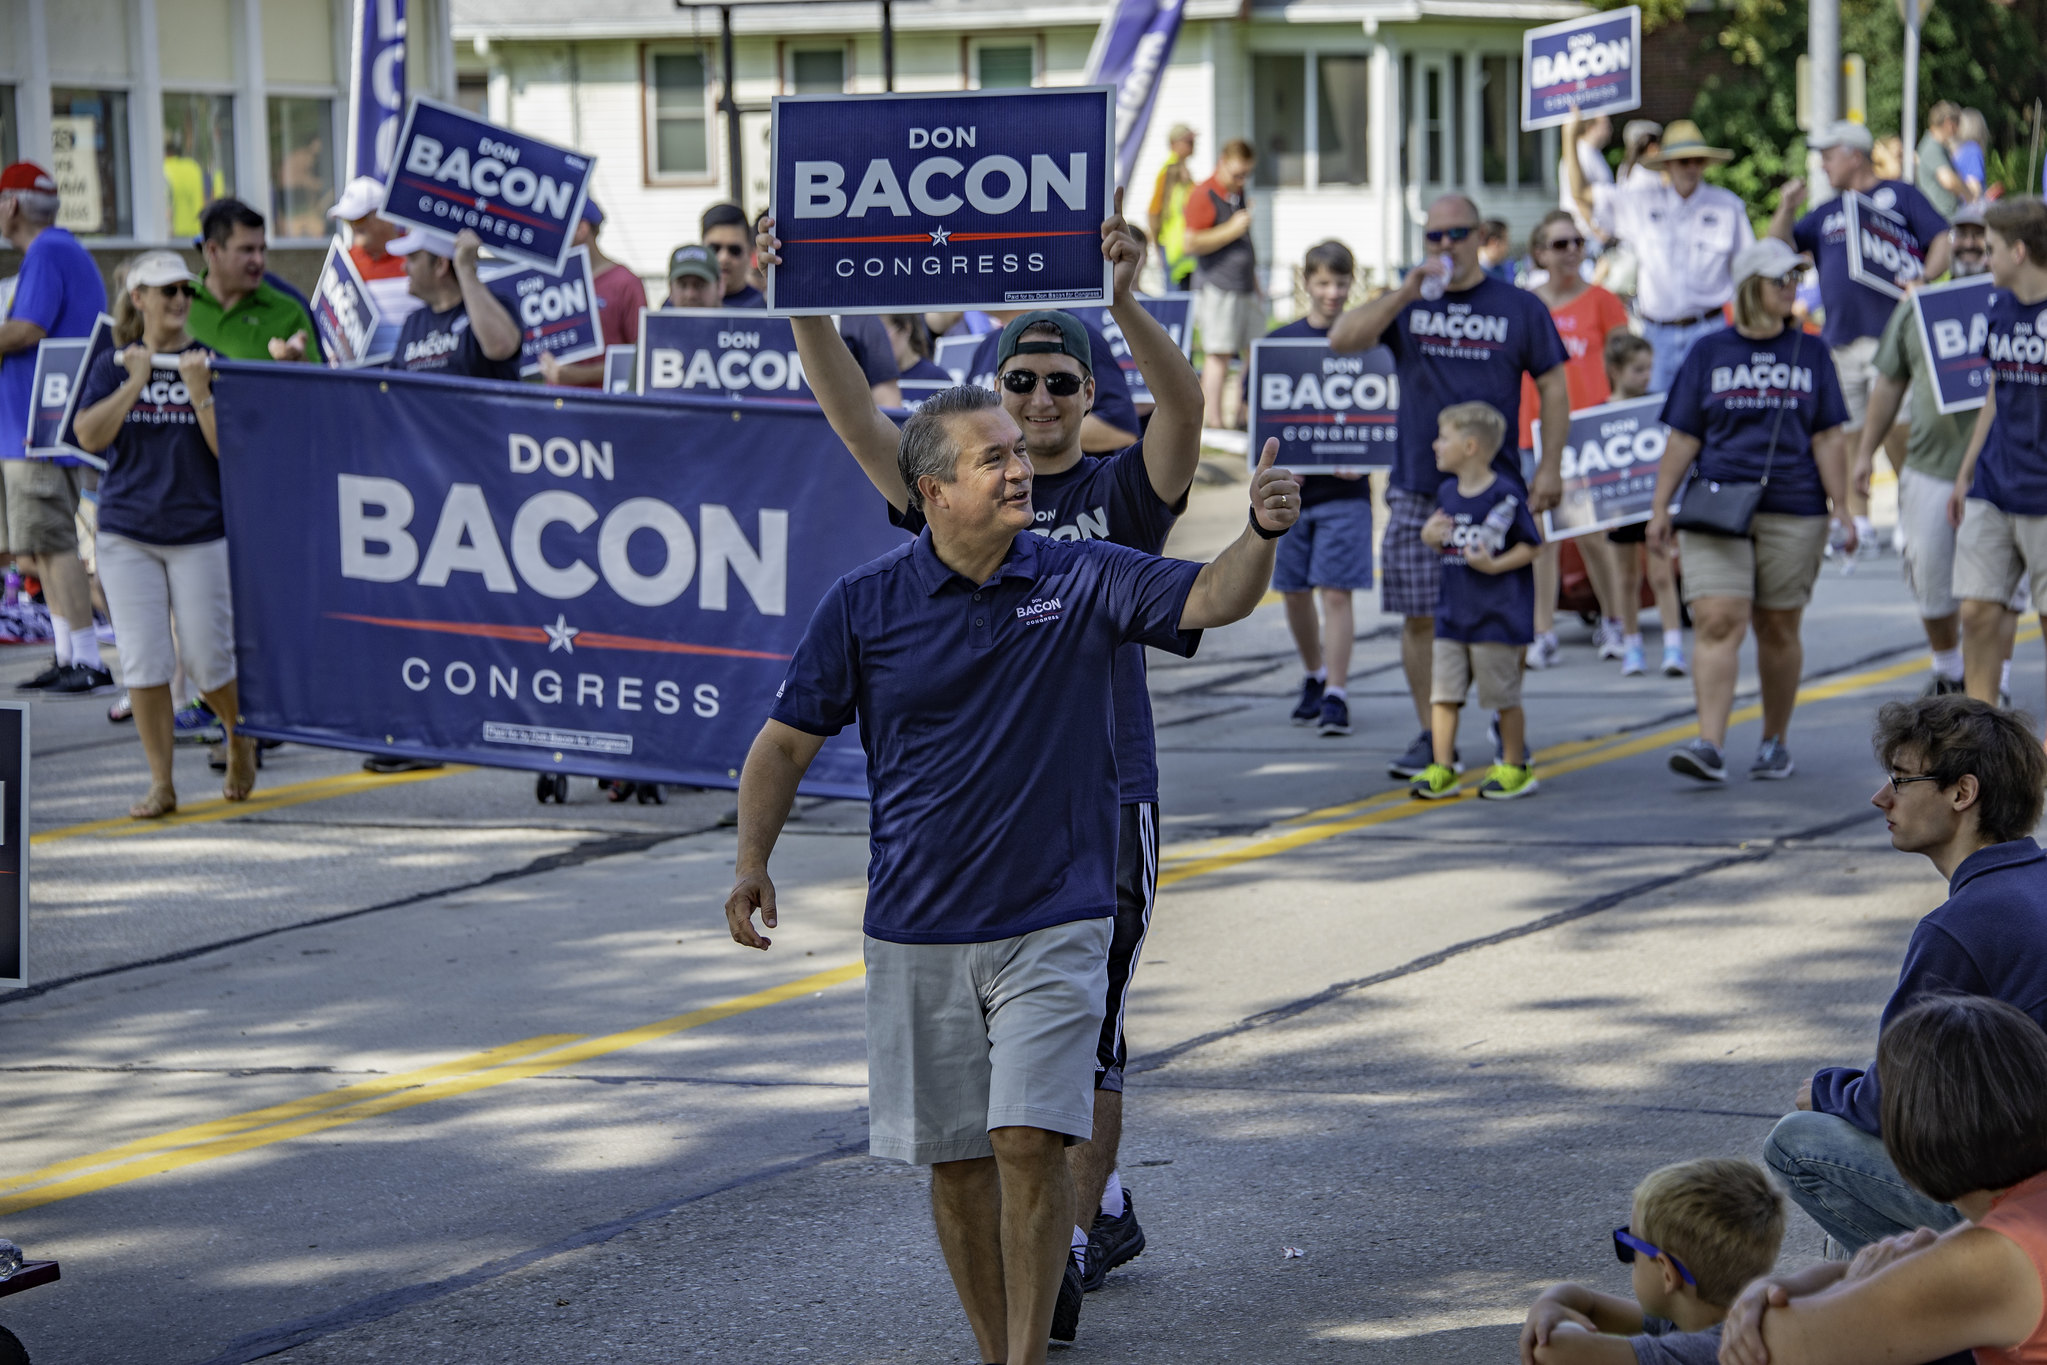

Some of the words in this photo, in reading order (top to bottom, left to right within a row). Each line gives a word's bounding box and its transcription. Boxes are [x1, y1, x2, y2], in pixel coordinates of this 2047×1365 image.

[1531, 37, 1631, 89] BACON
[478, 136, 520, 165] DON
[908, 126, 976, 150] DON
[405, 133, 574, 220] BACON
[793, 152, 1088, 219] BACON
[418, 195, 534, 245] CONGRESS
[836, 252, 1044, 277] CONGRESS
[520, 278, 587, 327] CON
[522, 328, 578, 356] NGRESS
[717, 331, 760, 350] DON
[1409, 309, 1508, 343] BACON
[1988, 332, 2047, 365] BACO
[1322, 357, 1363, 375] DON
[1711, 363, 1812, 394] BACON
[1283, 425, 1398, 442] CONGRESS
[1601, 416, 1639, 439] DON
[508, 434, 614, 481] DON
[1560, 426, 1671, 479] BACO
[1574, 473, 1657, 505] CONGRE
[337, 472, 789, 617] BACON
[1016, 598, 1062, 618] BACON
[1026, 615, 1059, 626] CONGRESS
[401, 656, 720, 718] CONGRESS
